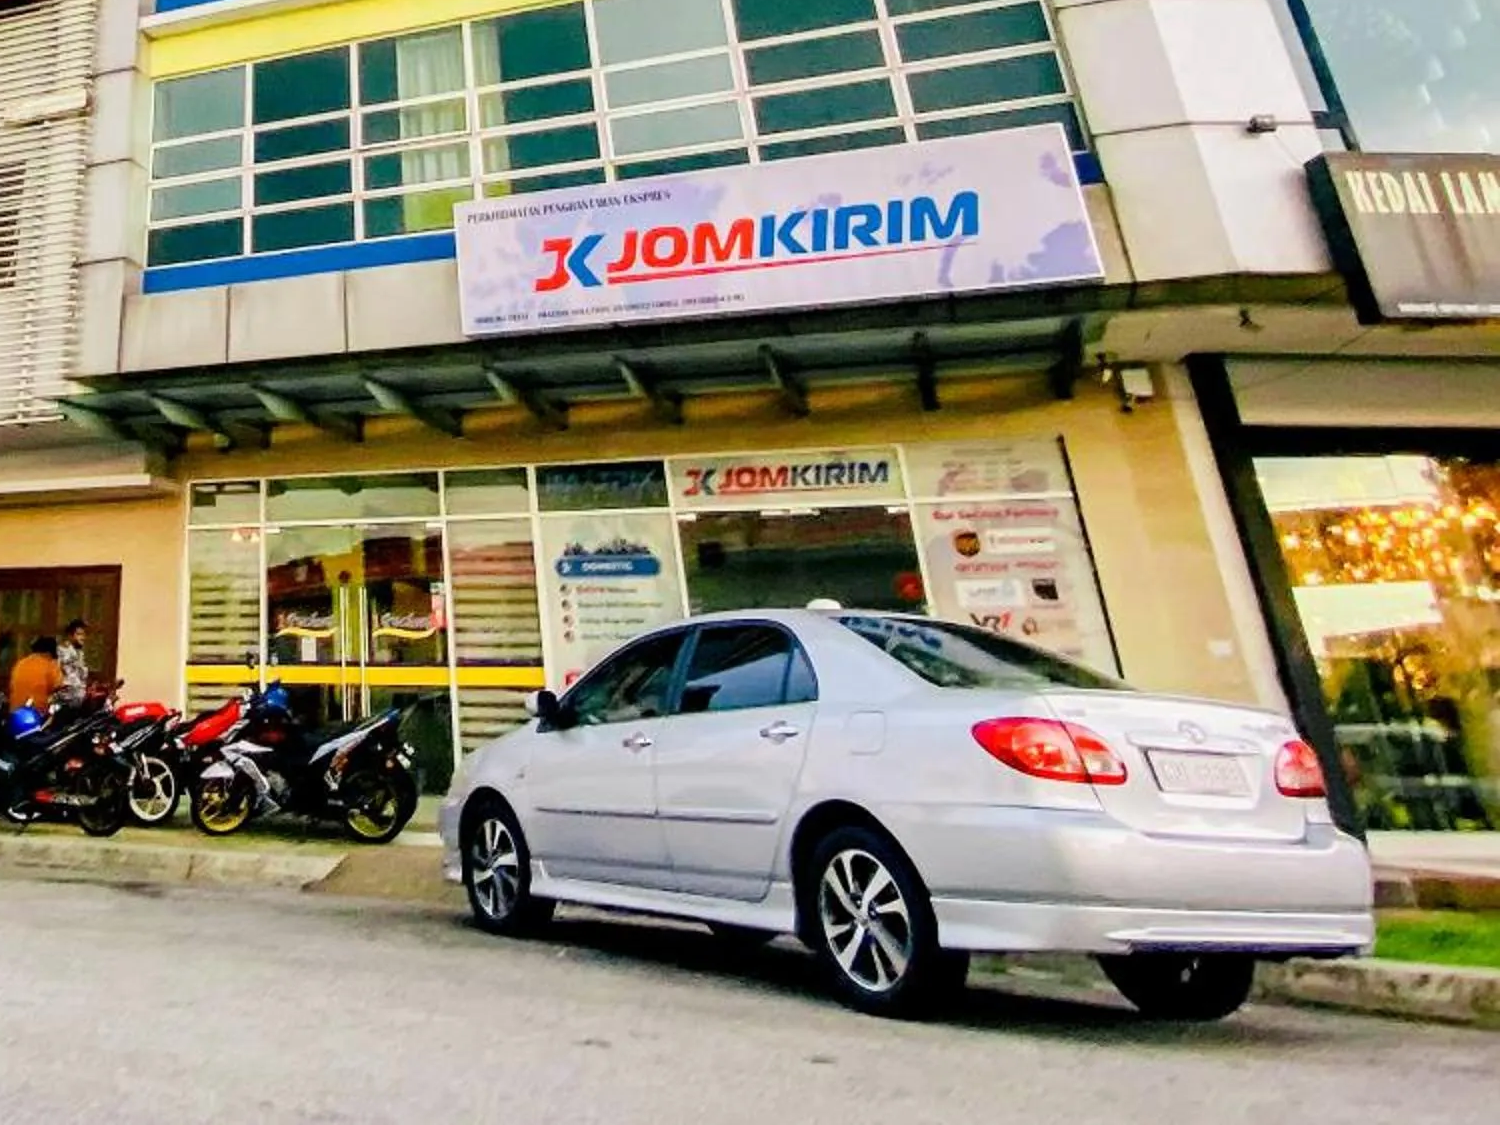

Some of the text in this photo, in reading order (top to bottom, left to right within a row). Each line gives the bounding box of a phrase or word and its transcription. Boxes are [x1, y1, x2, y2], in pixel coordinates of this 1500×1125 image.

[1344, 170, 1440, 214] KEDAI
[607, 191, 979, 274] JOMKIRIM
[718, 461, 889, 489] JOMKIRIM
